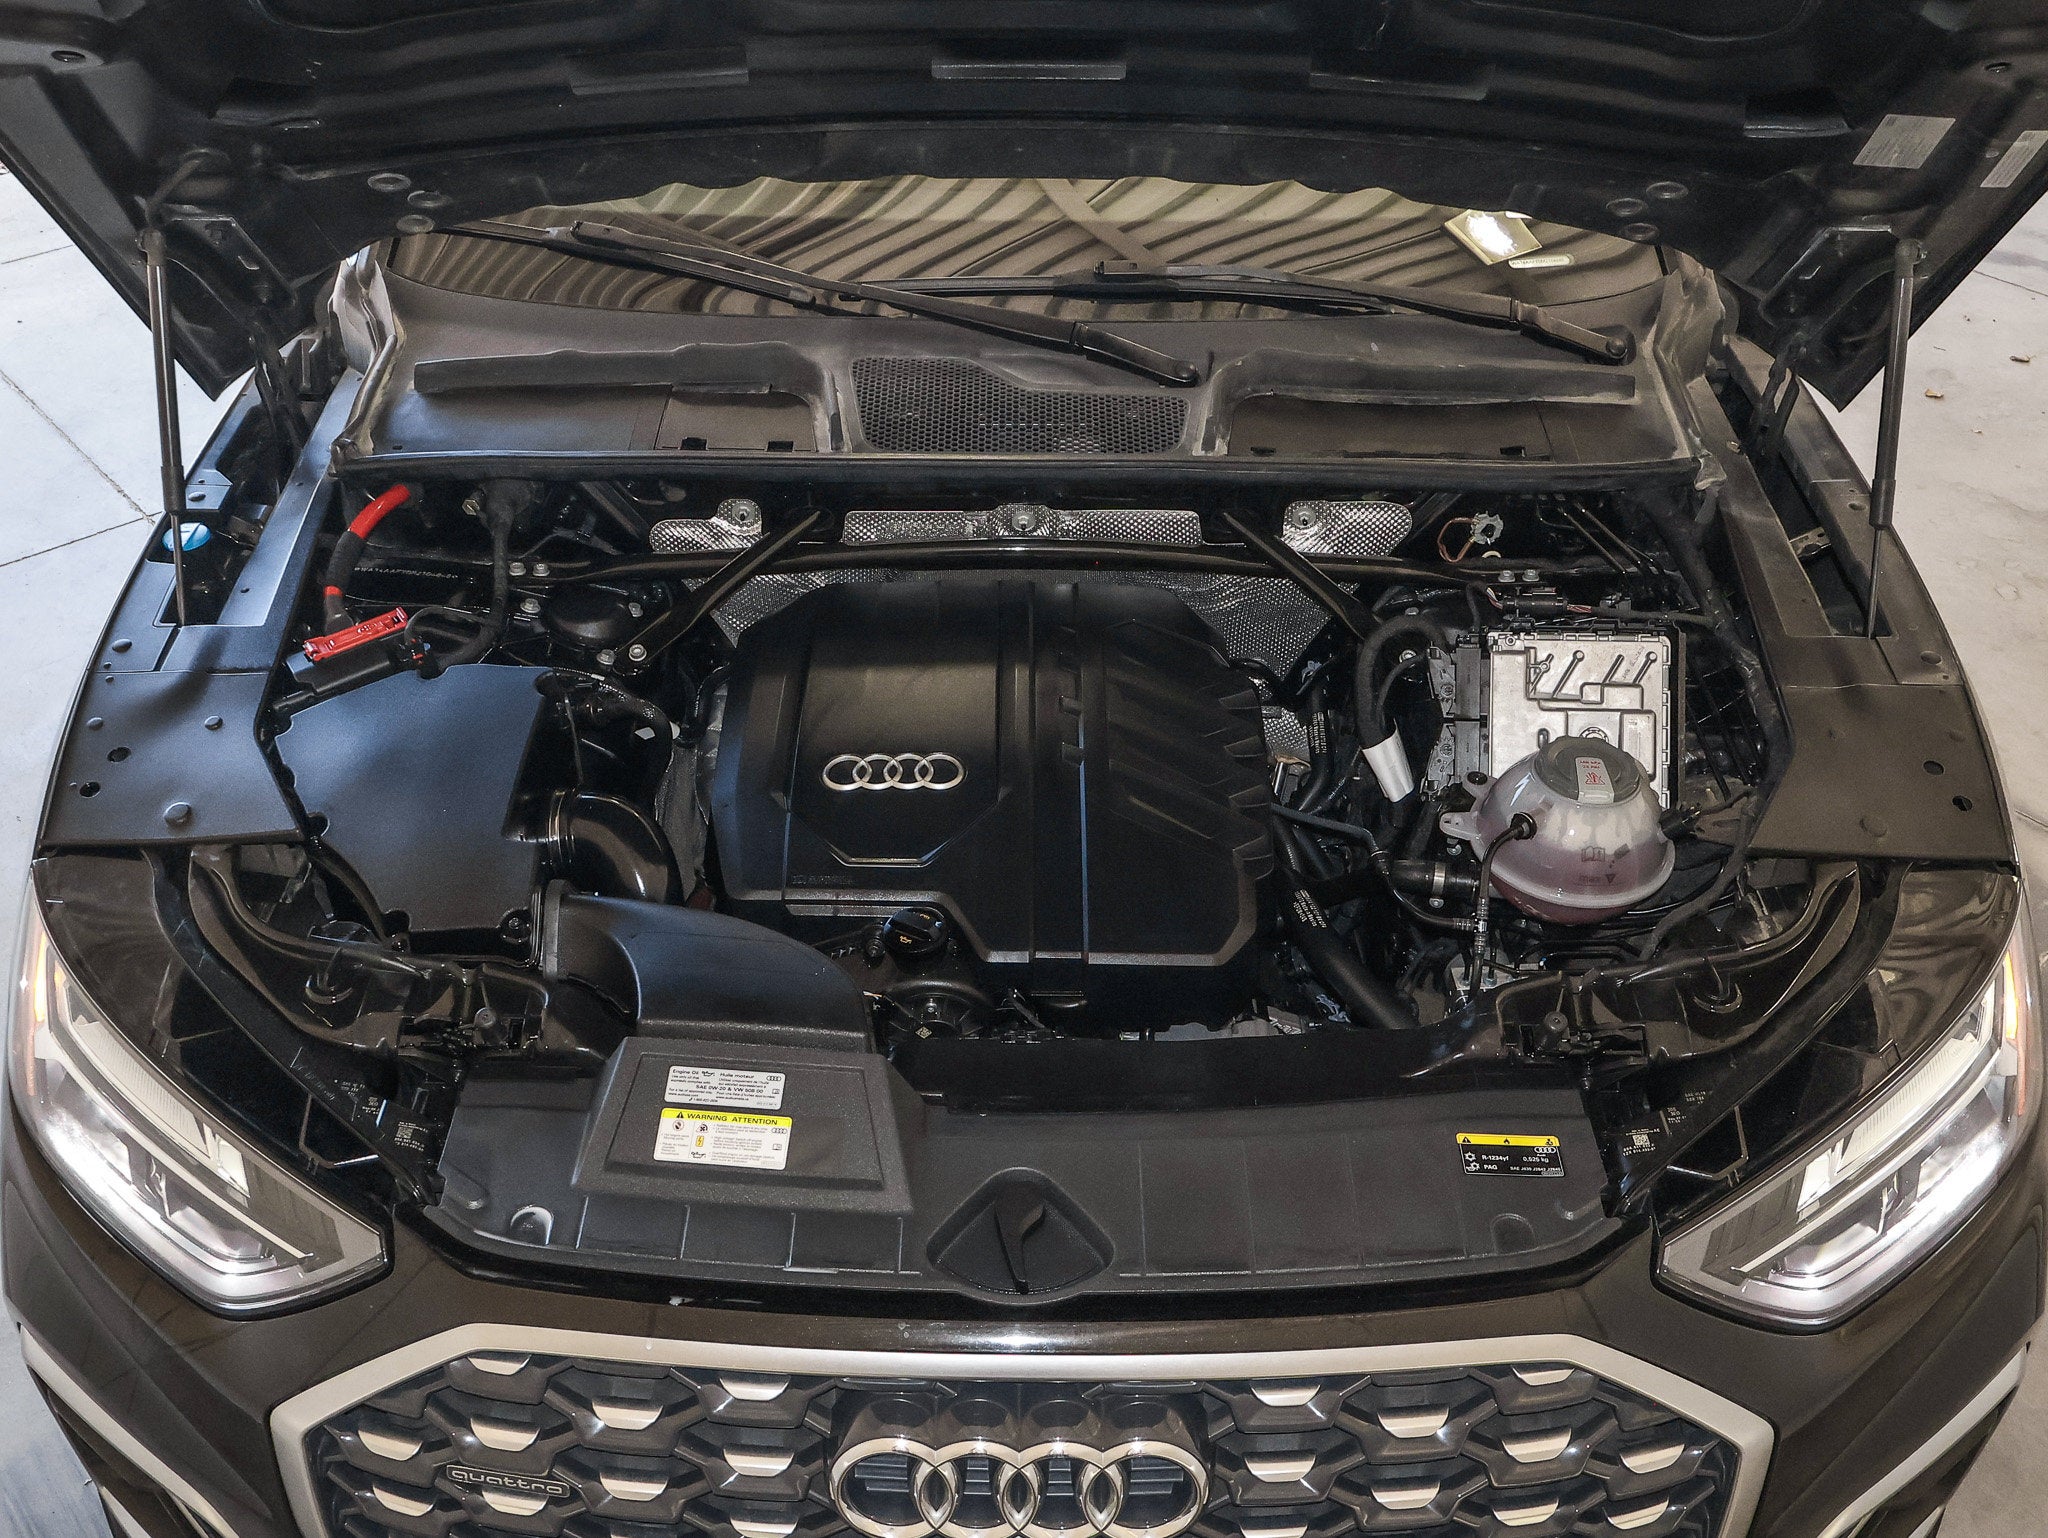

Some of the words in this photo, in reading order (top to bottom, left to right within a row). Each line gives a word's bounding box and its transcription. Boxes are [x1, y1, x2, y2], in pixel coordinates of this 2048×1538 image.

[687, 1113, 728, 1121] WARNING
[731, 1116, 778, 1125] ATTENTION
[1481, 1154, 1509, 1162] R-1234yf
[451, 1470, 563, 1494] quattro
